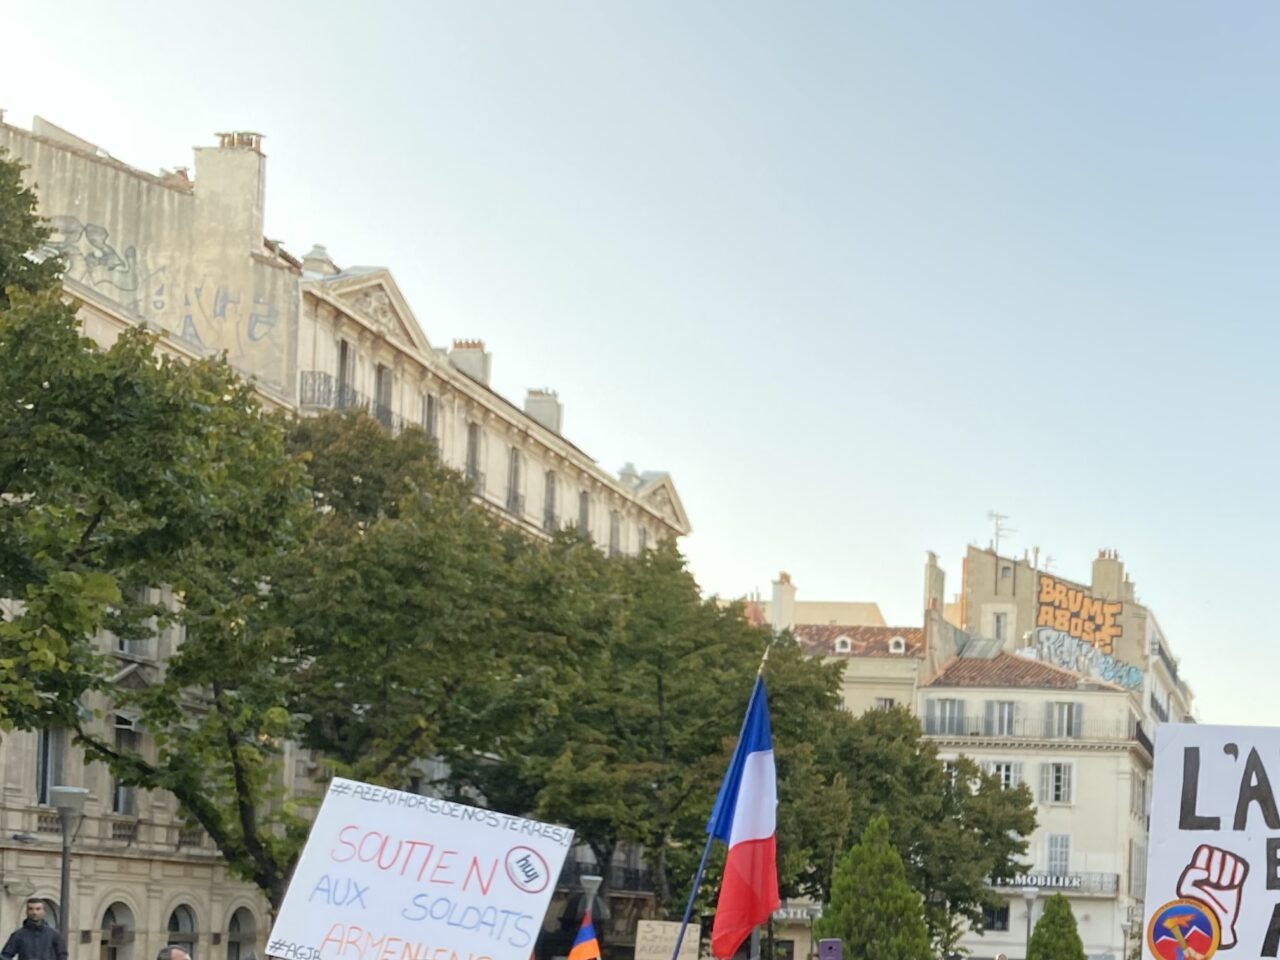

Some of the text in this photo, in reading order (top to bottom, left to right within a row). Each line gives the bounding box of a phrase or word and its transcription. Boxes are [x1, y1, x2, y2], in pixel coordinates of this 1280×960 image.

[331, 825, 499, 896] SOUTIEN
[996, 874, 1082, 888] IMOBILIER
[309, 874, 533, 948] AUX SOLDATS
